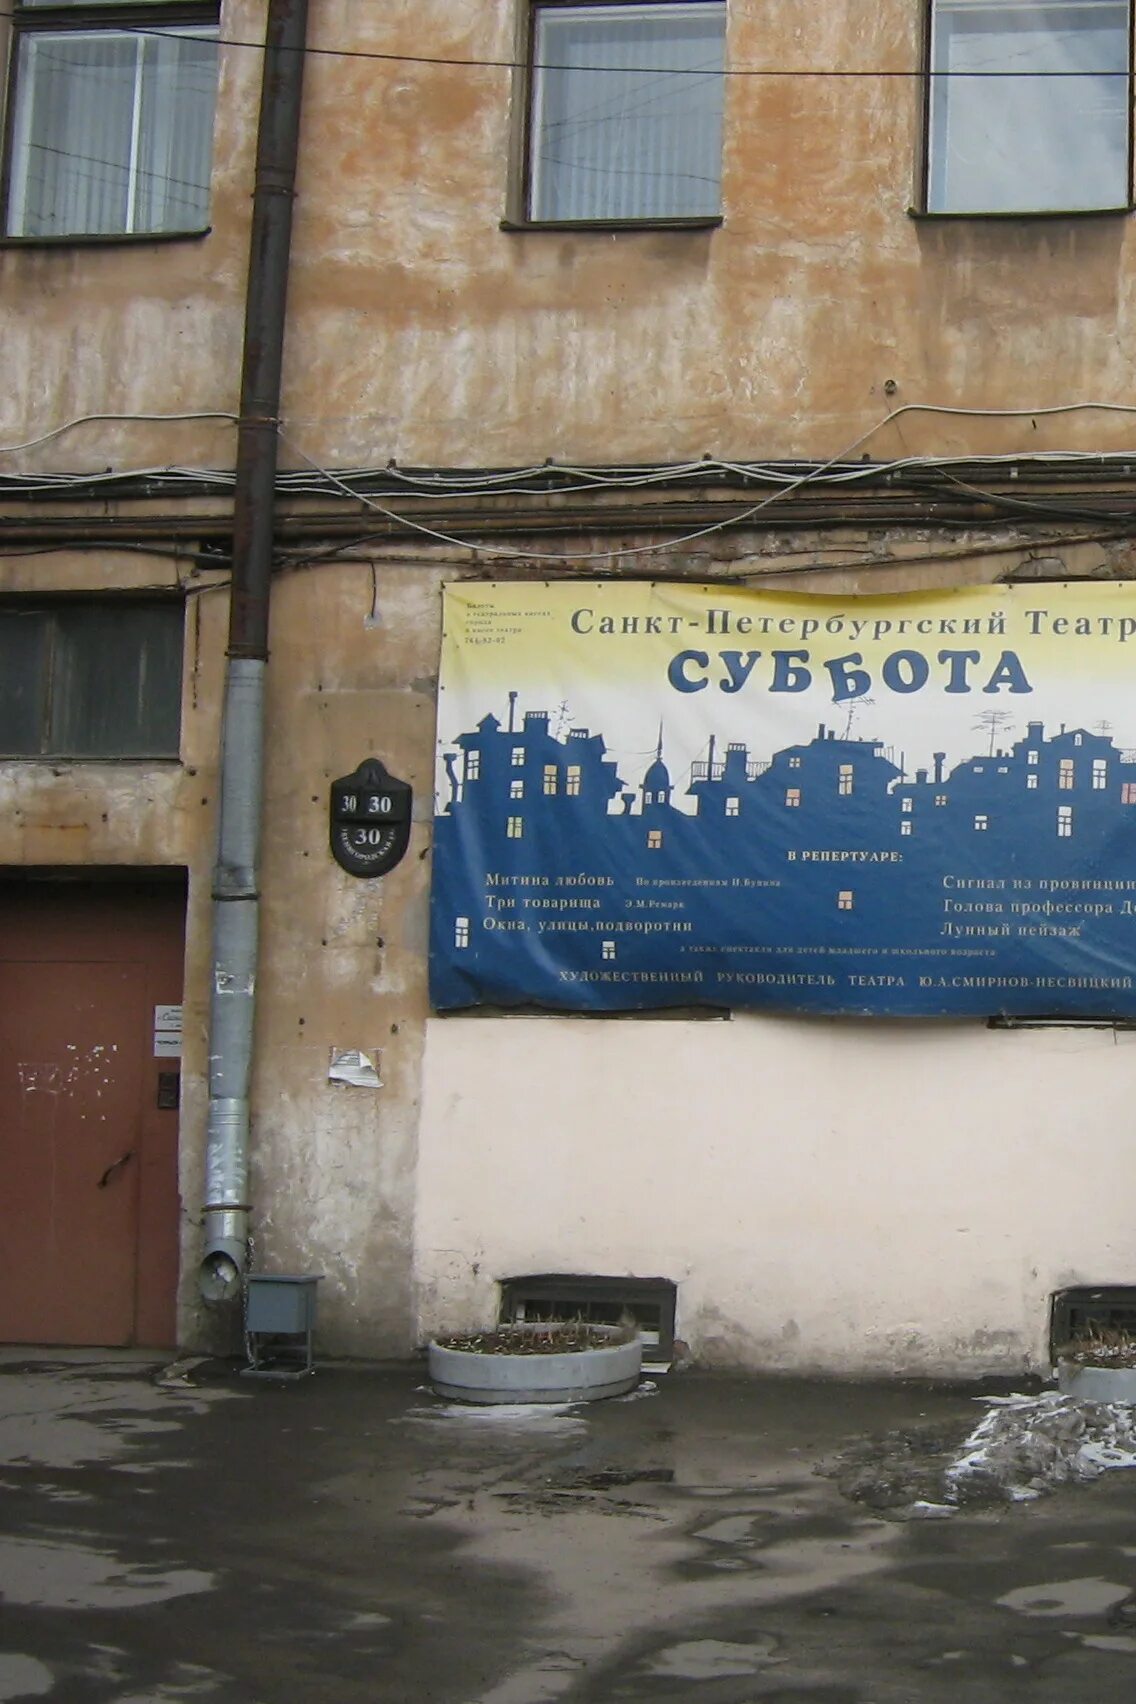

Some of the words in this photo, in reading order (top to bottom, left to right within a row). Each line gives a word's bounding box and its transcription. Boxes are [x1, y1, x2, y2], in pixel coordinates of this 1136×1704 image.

[571, 608, 1007, 641] Санкт-Петербургский
[668, 650, 1033, 703] СУББОТА
[342, 795, 357, 812] 30
[368, 796, 392, 813] 30
[355, 828, 381, 845] 30
[787, 851, 796, 861] В
[802, 851, 903, 862] РЕПЕРТУАРЕ:
[485, 873, 549, 887] Митина
[555, 872, 615, 887] любовь
[943, 875, 1005, 889] Сигнал
[1012, 879, 1032, 889] из
[1039, 879, 1136, 892] провинции
[485, 895, 515, 911] Три
[524, 898, 601, 911] товарища
[943, 899, 1003, 913] Голова
[1011, 899, 1113, 917] профессора
[483, 917, 531, 931] Окна,
[940, 922, 1010, 939] Лунный
[1018, 922, 1081, 937] пейзаж
[559, 970, 703, 983] ХУДОЖЕСТВЕННЫЙ
[716, 971, 835, 986] РУКОВОДИТЕЛЬ
[848, 975, 905, 986] ТЕАТРА
